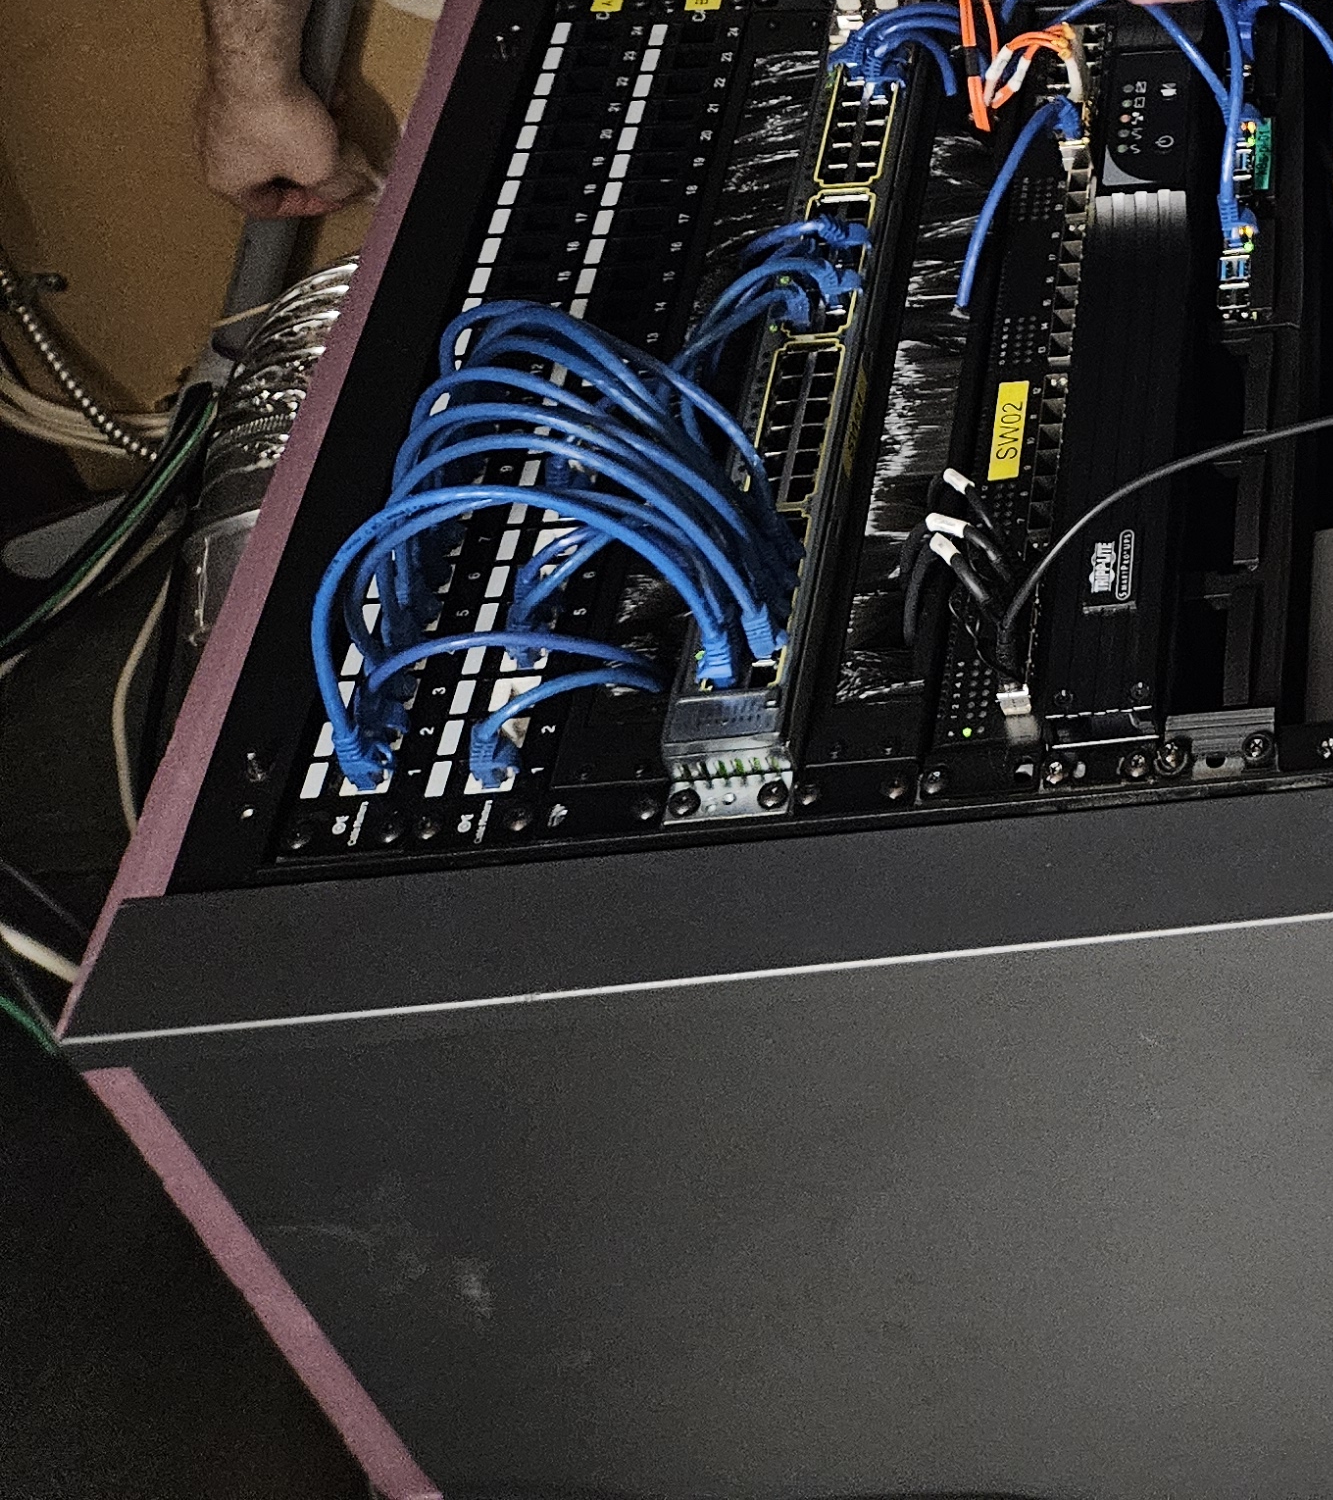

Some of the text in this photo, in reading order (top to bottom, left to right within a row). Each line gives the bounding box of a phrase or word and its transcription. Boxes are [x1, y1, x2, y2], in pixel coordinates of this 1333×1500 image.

[995, 400, 1024, 460] SW02
[1121, 532, 1132, 549] UPS
[457, 608, 469, 618] 5
[432, 686, 447, 696] 3
[420, 726, 435, 736] 2
[541, 725, 556, 735] 2
